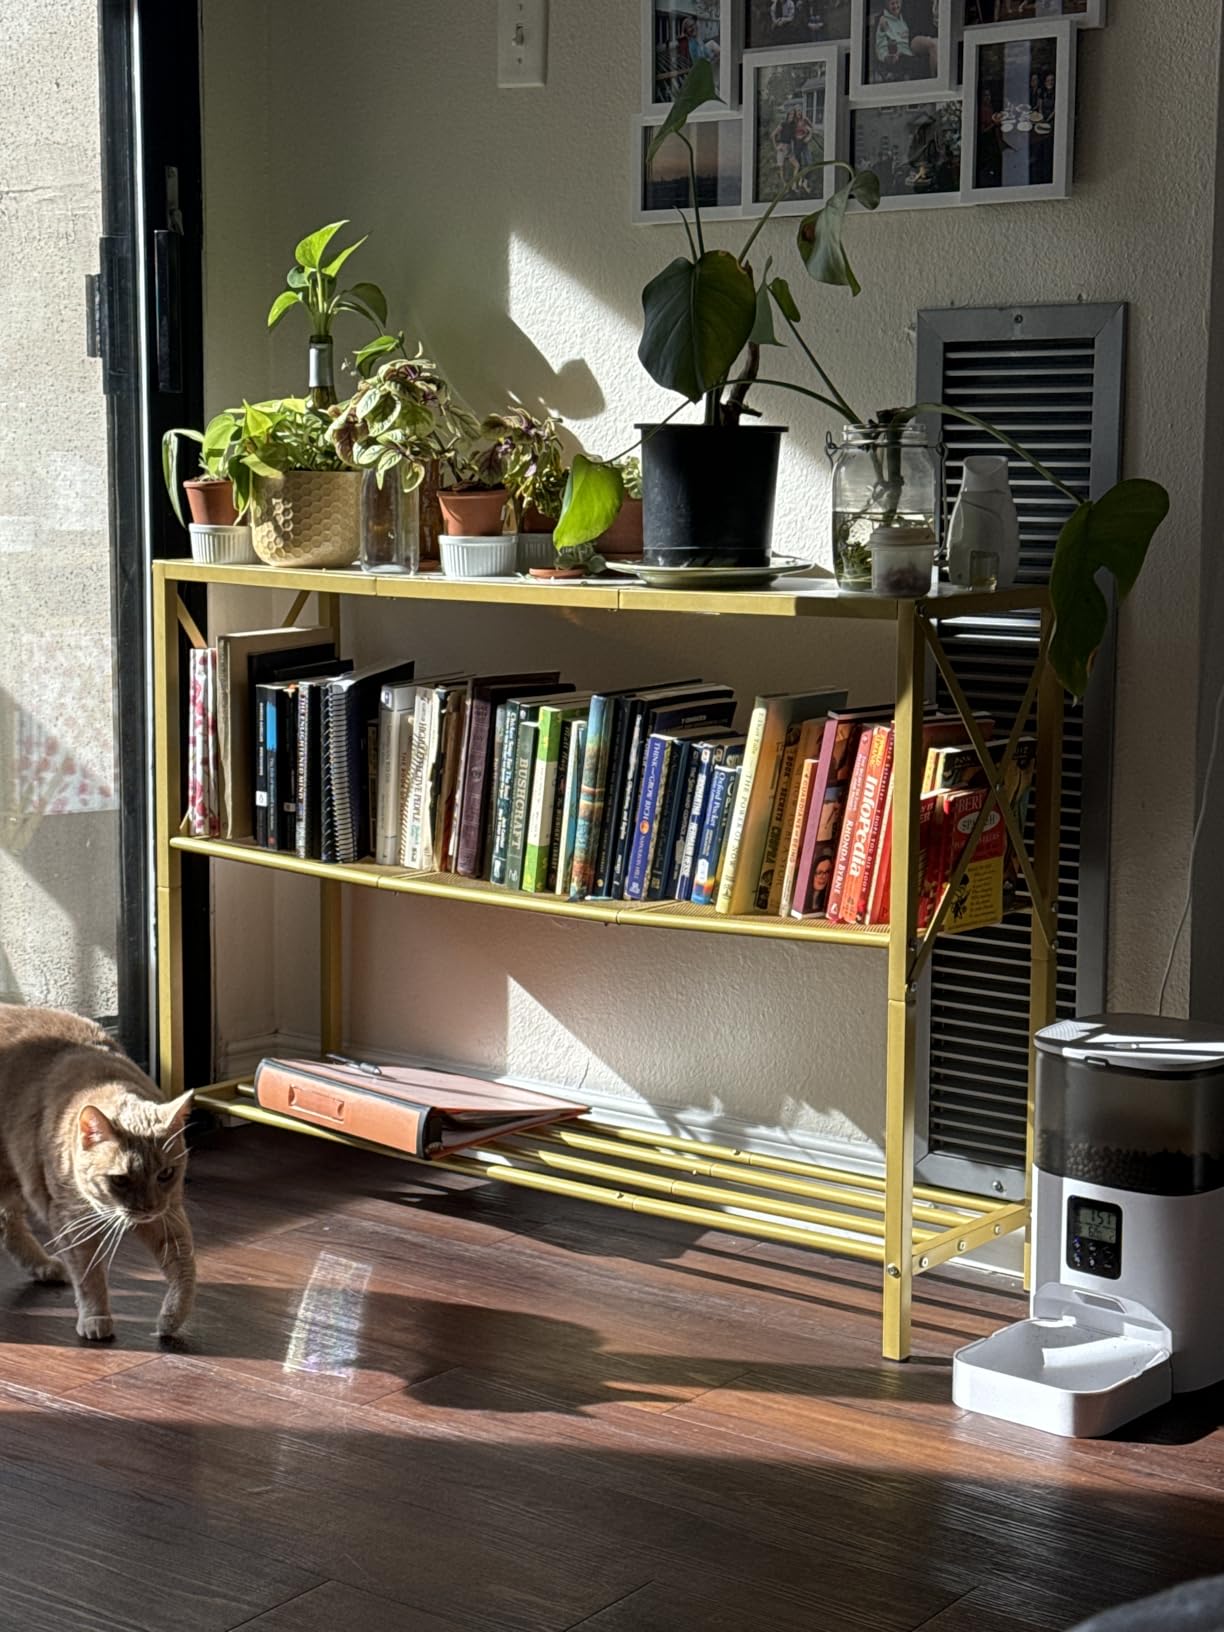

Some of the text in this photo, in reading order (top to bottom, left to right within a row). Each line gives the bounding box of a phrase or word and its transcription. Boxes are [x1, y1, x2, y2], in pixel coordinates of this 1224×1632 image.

[507, 712, 516, 740] Chicken
[651, 741, 661, 767] THINK
[743, 774, 753, 792] THE
[775, 756, 794, 822] BOOK SECRETS
[511, 758, 529, 850] BUSHCRAFT
[643, 800, 652, 820] RICH
[710, 772, 726, 827] Oxford Pocket
[736, 796, 749, 829] POWER
[795, 780, 808, 829] GUARDIANS
[849, 775, 878, 878] InfoPedia
[551, 842, 559, 870] LIBRARY
[728, 846, 739, 869] NOW
[765, 826, 781, 864] CHOPRA
[789, 838, 799, 863] BEING
[833, 819, 854, 895] RHONDA BYRNE
[861, 872, 869, 893] SOON
